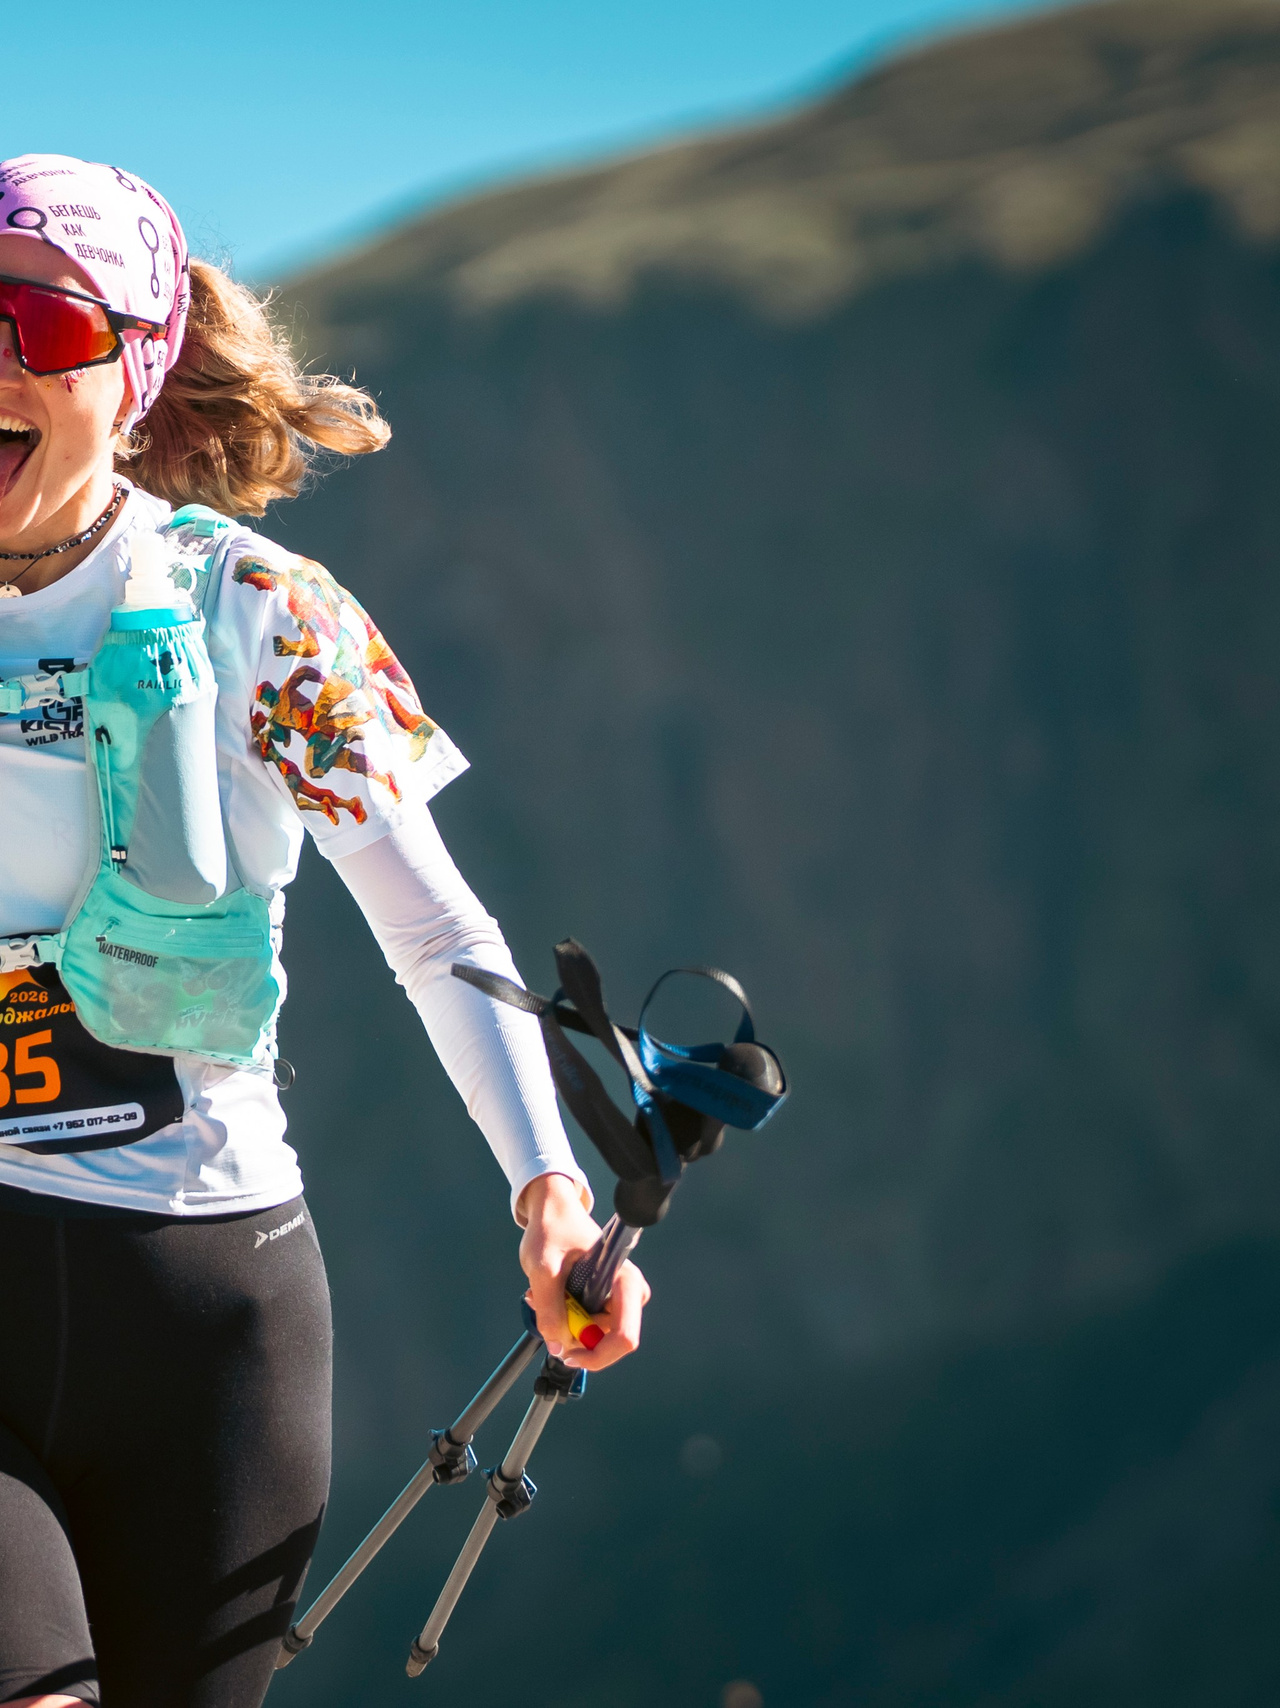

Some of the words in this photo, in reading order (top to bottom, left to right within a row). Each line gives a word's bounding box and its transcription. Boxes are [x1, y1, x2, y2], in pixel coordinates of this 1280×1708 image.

[48, 204, 101, 220] БЕГАЕШЬ
[61, 223, 87, 237] КАК
[74, 243, 126, 269] ДЕВЧОНКА
[25, 733, 59, 746] WILD
[98, 941, 160, 968] WATERPROOF
[9, 991, 49, 1004] 2026
[52, 1121, 64, 1131] +7
[65, 1119, 85, 1130] 962
[86, 1112, 138, 1127] 017-82-09
[268, 1211, 306, 1241] DEMIX
